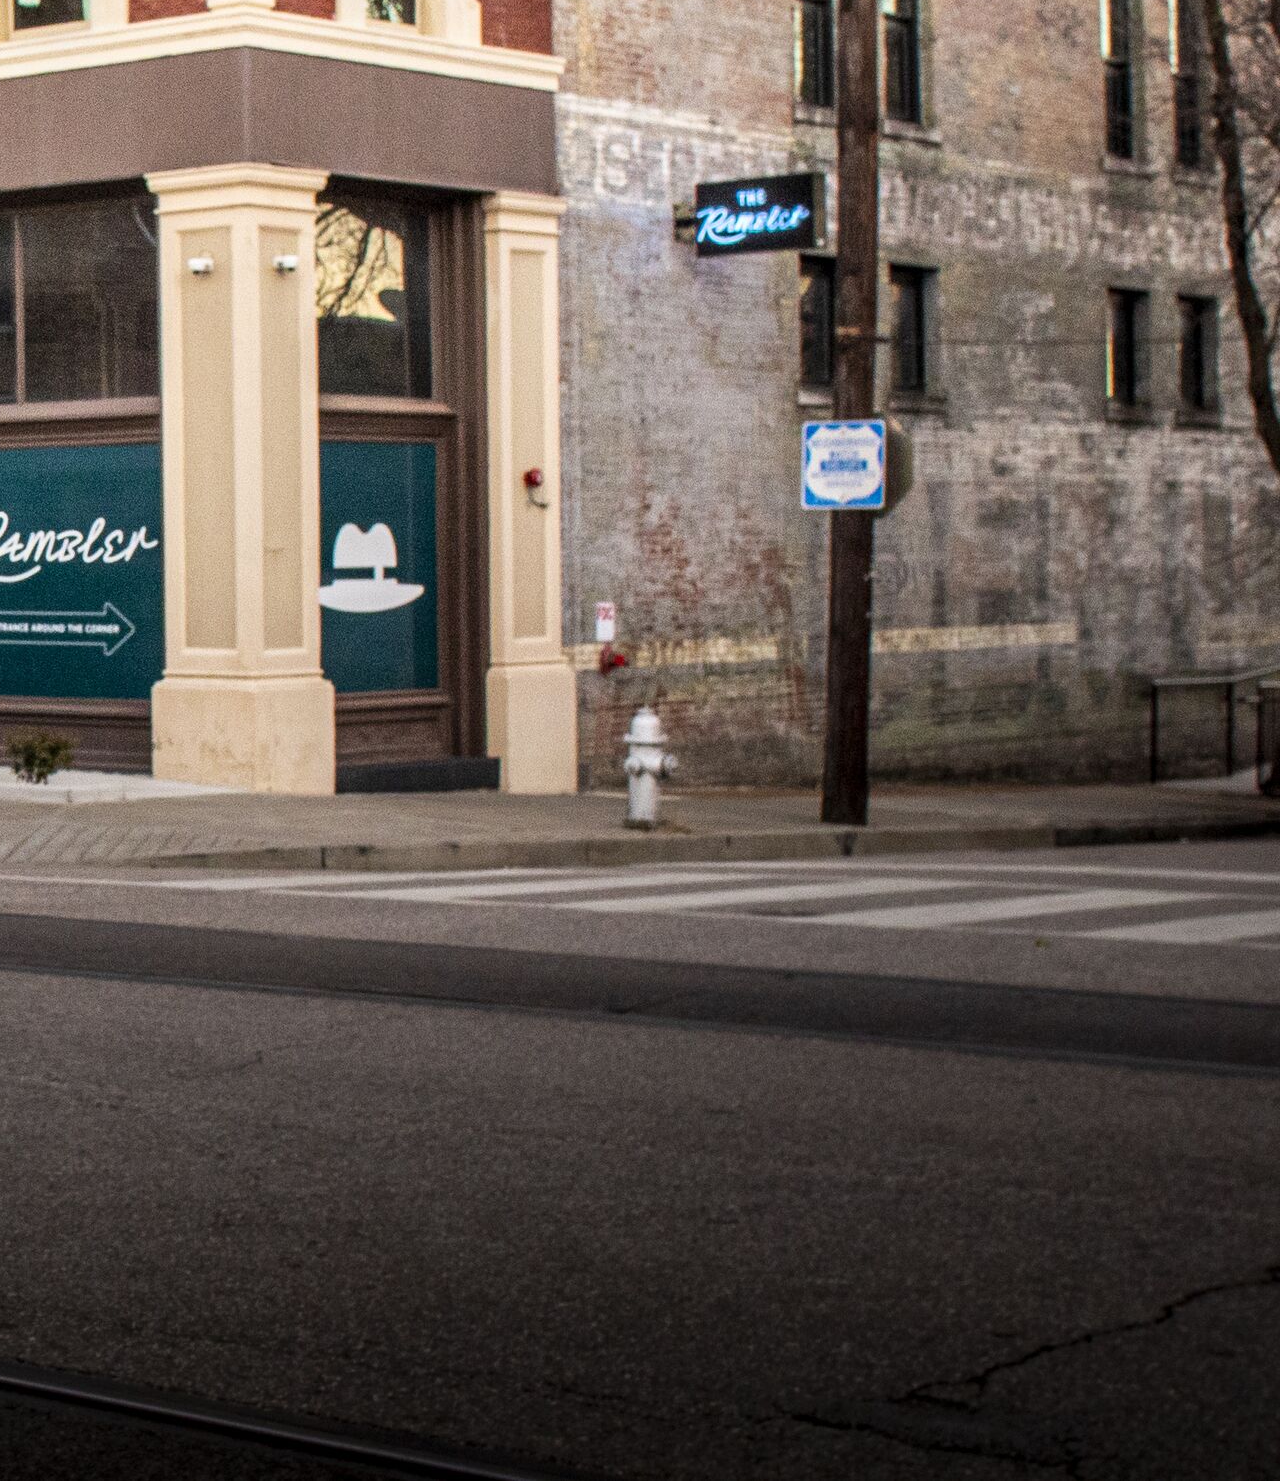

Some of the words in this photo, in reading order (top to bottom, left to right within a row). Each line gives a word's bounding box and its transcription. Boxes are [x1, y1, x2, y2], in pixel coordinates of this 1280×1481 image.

[736, 188, 767, 207] THE
[31, 623, 66, 634] AROUND
[68, 624, 83, 634] THE
[85, 624, 120, 634] CORNER
